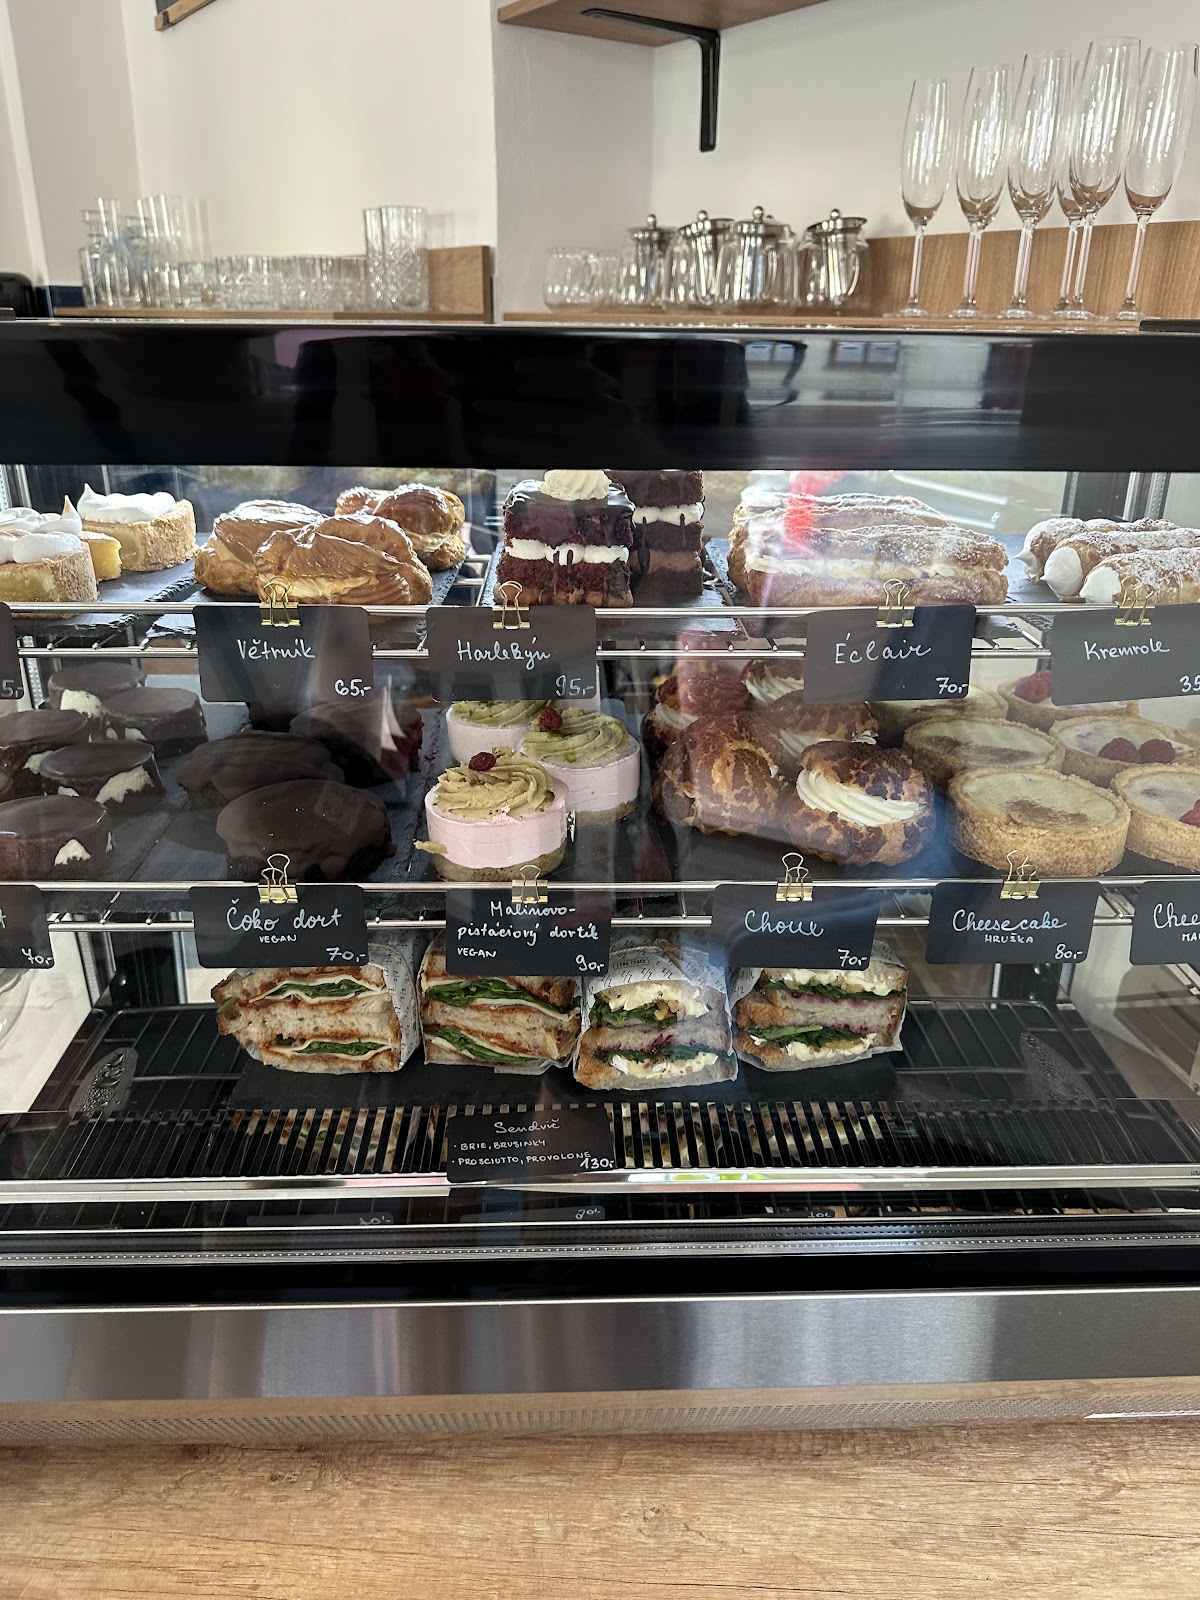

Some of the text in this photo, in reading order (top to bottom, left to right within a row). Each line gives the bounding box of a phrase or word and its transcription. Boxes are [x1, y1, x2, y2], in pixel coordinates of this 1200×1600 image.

[835, 632, 932, 664] Éclair
[1084, 638, 1171, 660] Kremrole
[334, 678, 372, 697] 65,-
[555, 674, 595, 697] 95,-
[936, 677, 969, 695] 70,-
[226, 898, 343, 932] Čoko dort
[490, 900, 577, 918] Malinovo-
[952, 909, 1068, 932] Cheesecake
[259, 934, 297, 944] VEGAN
[457, 922, 599, 947] pistáciový dortík
[984, 932, 1034, 944] HRUŠKA
[325, 946, 366, 963] 70,-
[457, 947, 497, 959] VEGAN
[837, 948, 868, 967] 70,-
[1054, 943, 1084, 961] 80,-
[575, 954, 605, 973] 90,-
[493, 1118, 560, 1134] Sendvič
[458, 1151, 592, 1166] PROSCIUTTO, PROVOLONE
